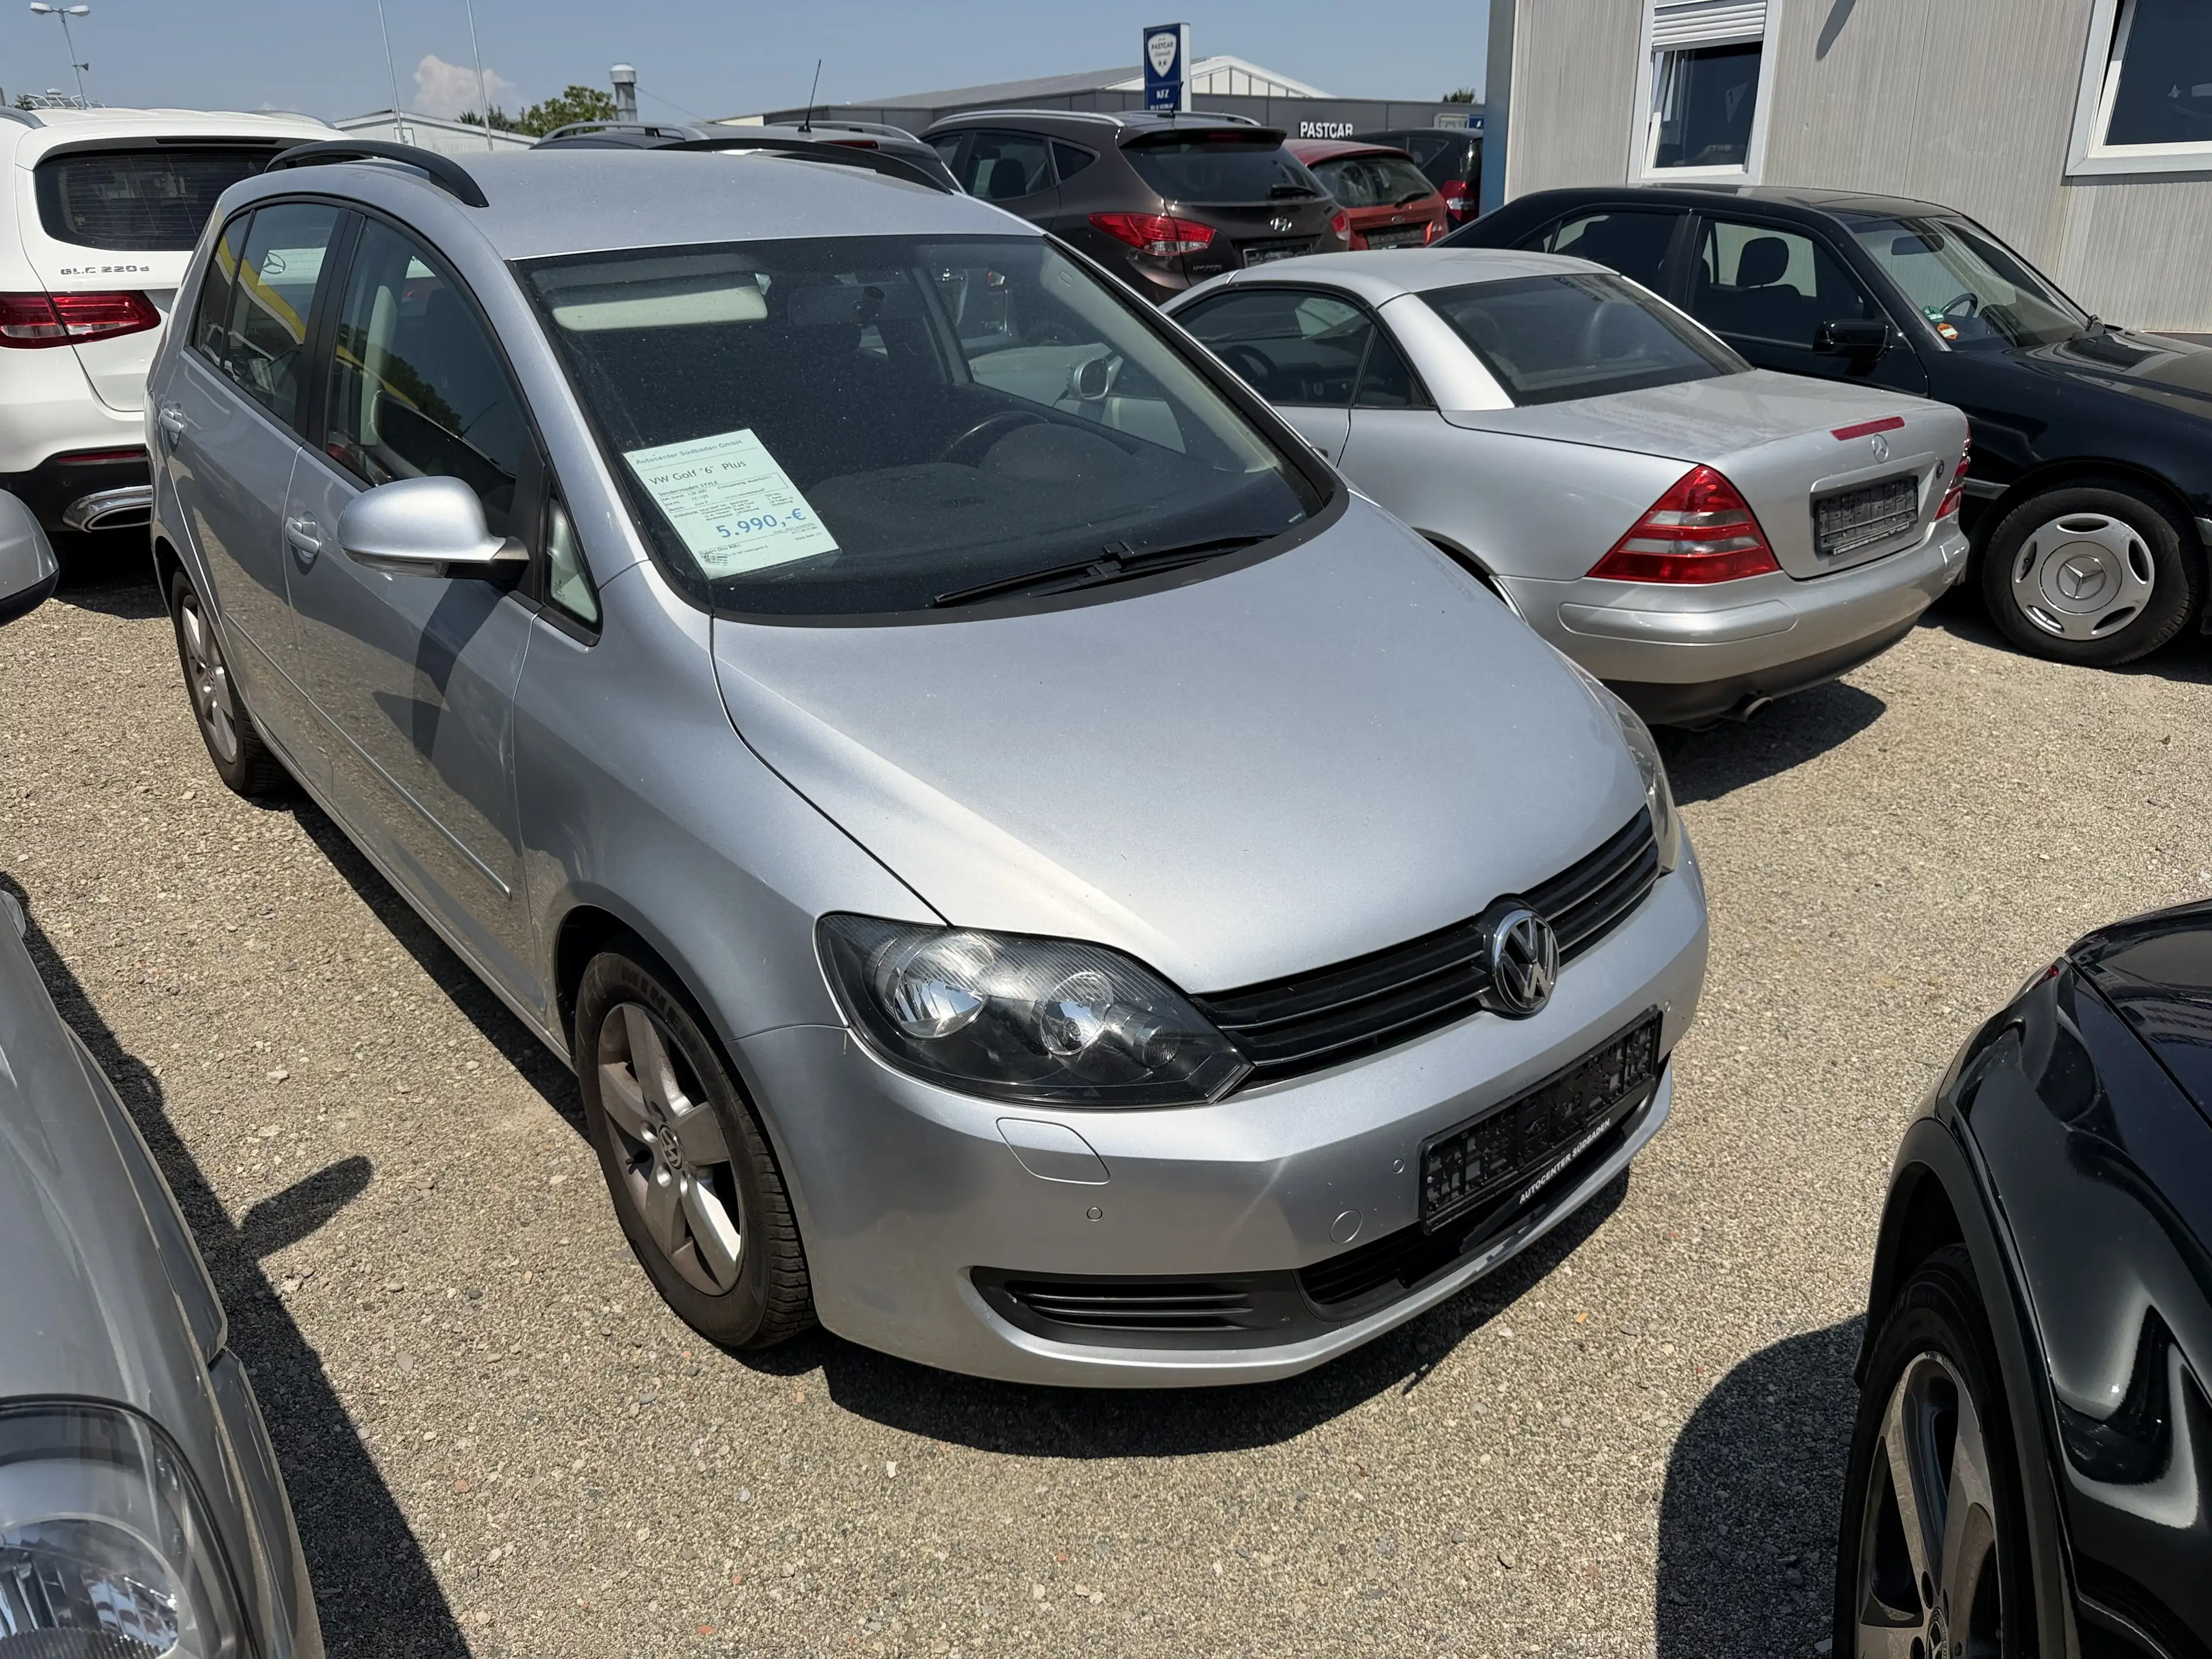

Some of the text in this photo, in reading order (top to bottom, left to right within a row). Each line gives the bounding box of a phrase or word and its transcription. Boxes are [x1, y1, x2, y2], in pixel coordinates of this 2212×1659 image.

[1300, 121, 1354, 138] PASTCAR
[636, 440, 743, 464] Autocenter Südbaden GmbH
[649, 475, 669, 484] VW
[673, 469, 697, 480] Golf
[722, 460, 747, 470] Plus
[658, 484, 699, 496] Sondermodell
[700, 480, 719, 490] STYLE
[716, 507, 806, 538] 5.990,-€
[1519, 1118, 1611, 1205] AUTOCENTER SÜDBADEN
